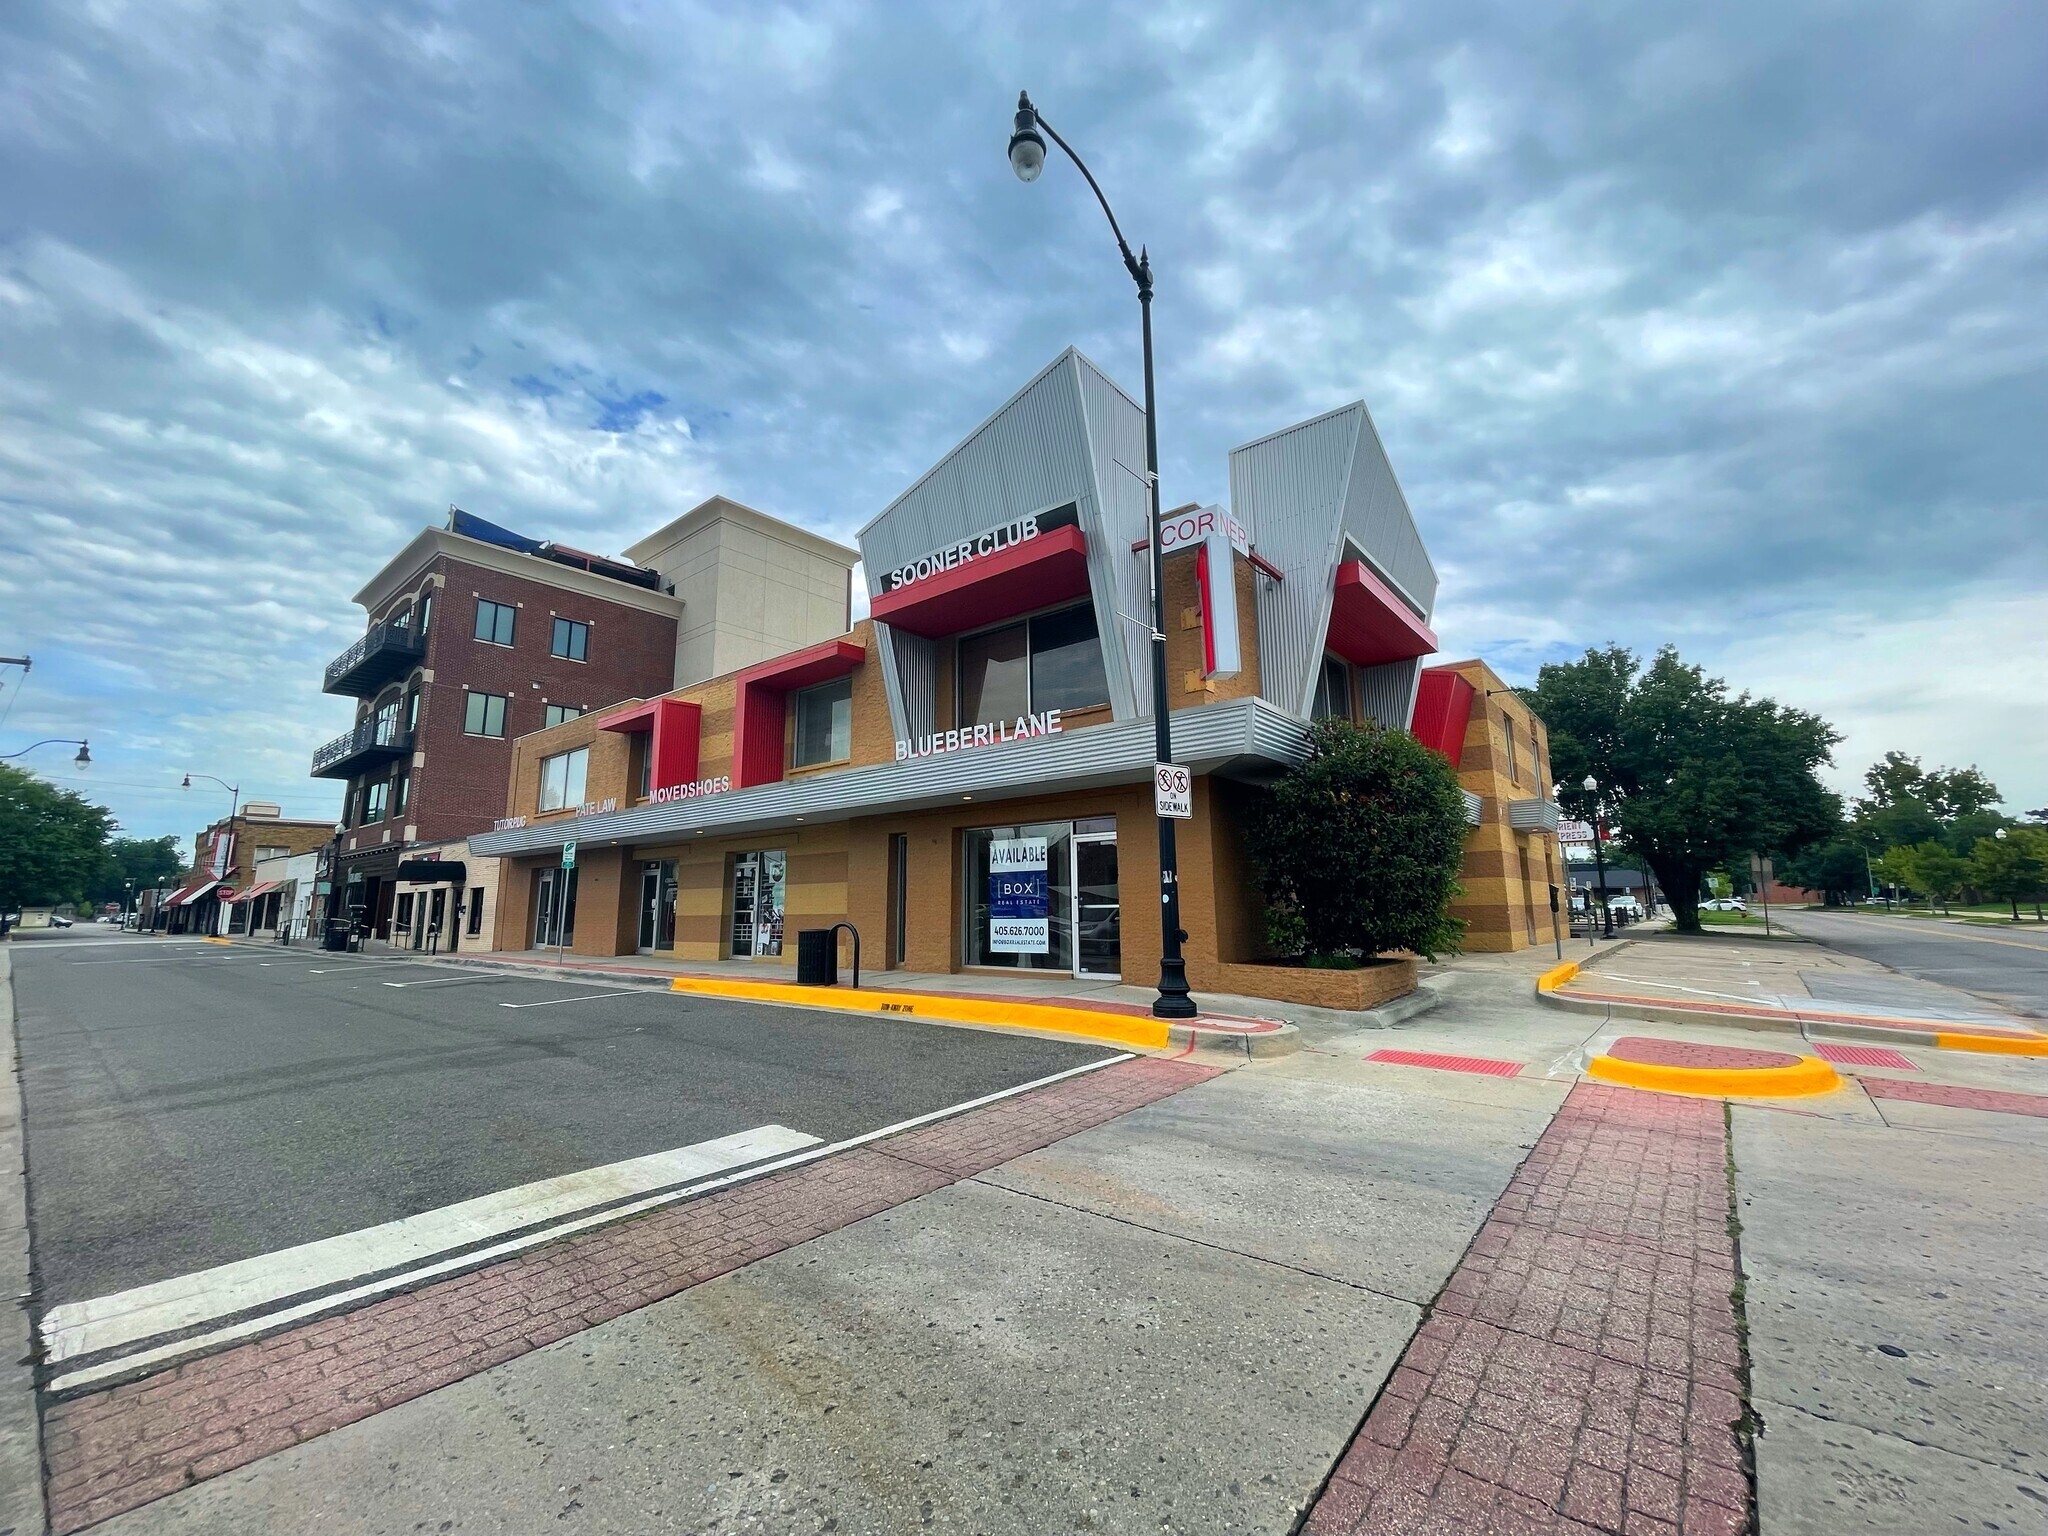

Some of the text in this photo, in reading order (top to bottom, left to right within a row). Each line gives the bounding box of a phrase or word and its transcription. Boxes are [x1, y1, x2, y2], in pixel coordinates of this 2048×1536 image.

[891, 516, 1040, 590] SOONER CLUB
[895, 709, 1063, 761] BLUEBERI LANE
[649, 775, 730, 804] MOVEDSHOES
[576, 797, 617, 817] PATE LAW
[1159, 801, 1189, 812] SIDEWALK
[1558, 822, 1581, 831] RIENT
[1560, 831, 1587, 839] PRESS
[992, 846, 1046, 864] AVAILABLE
[994, 926, 1045, 936] 405.626.7000
